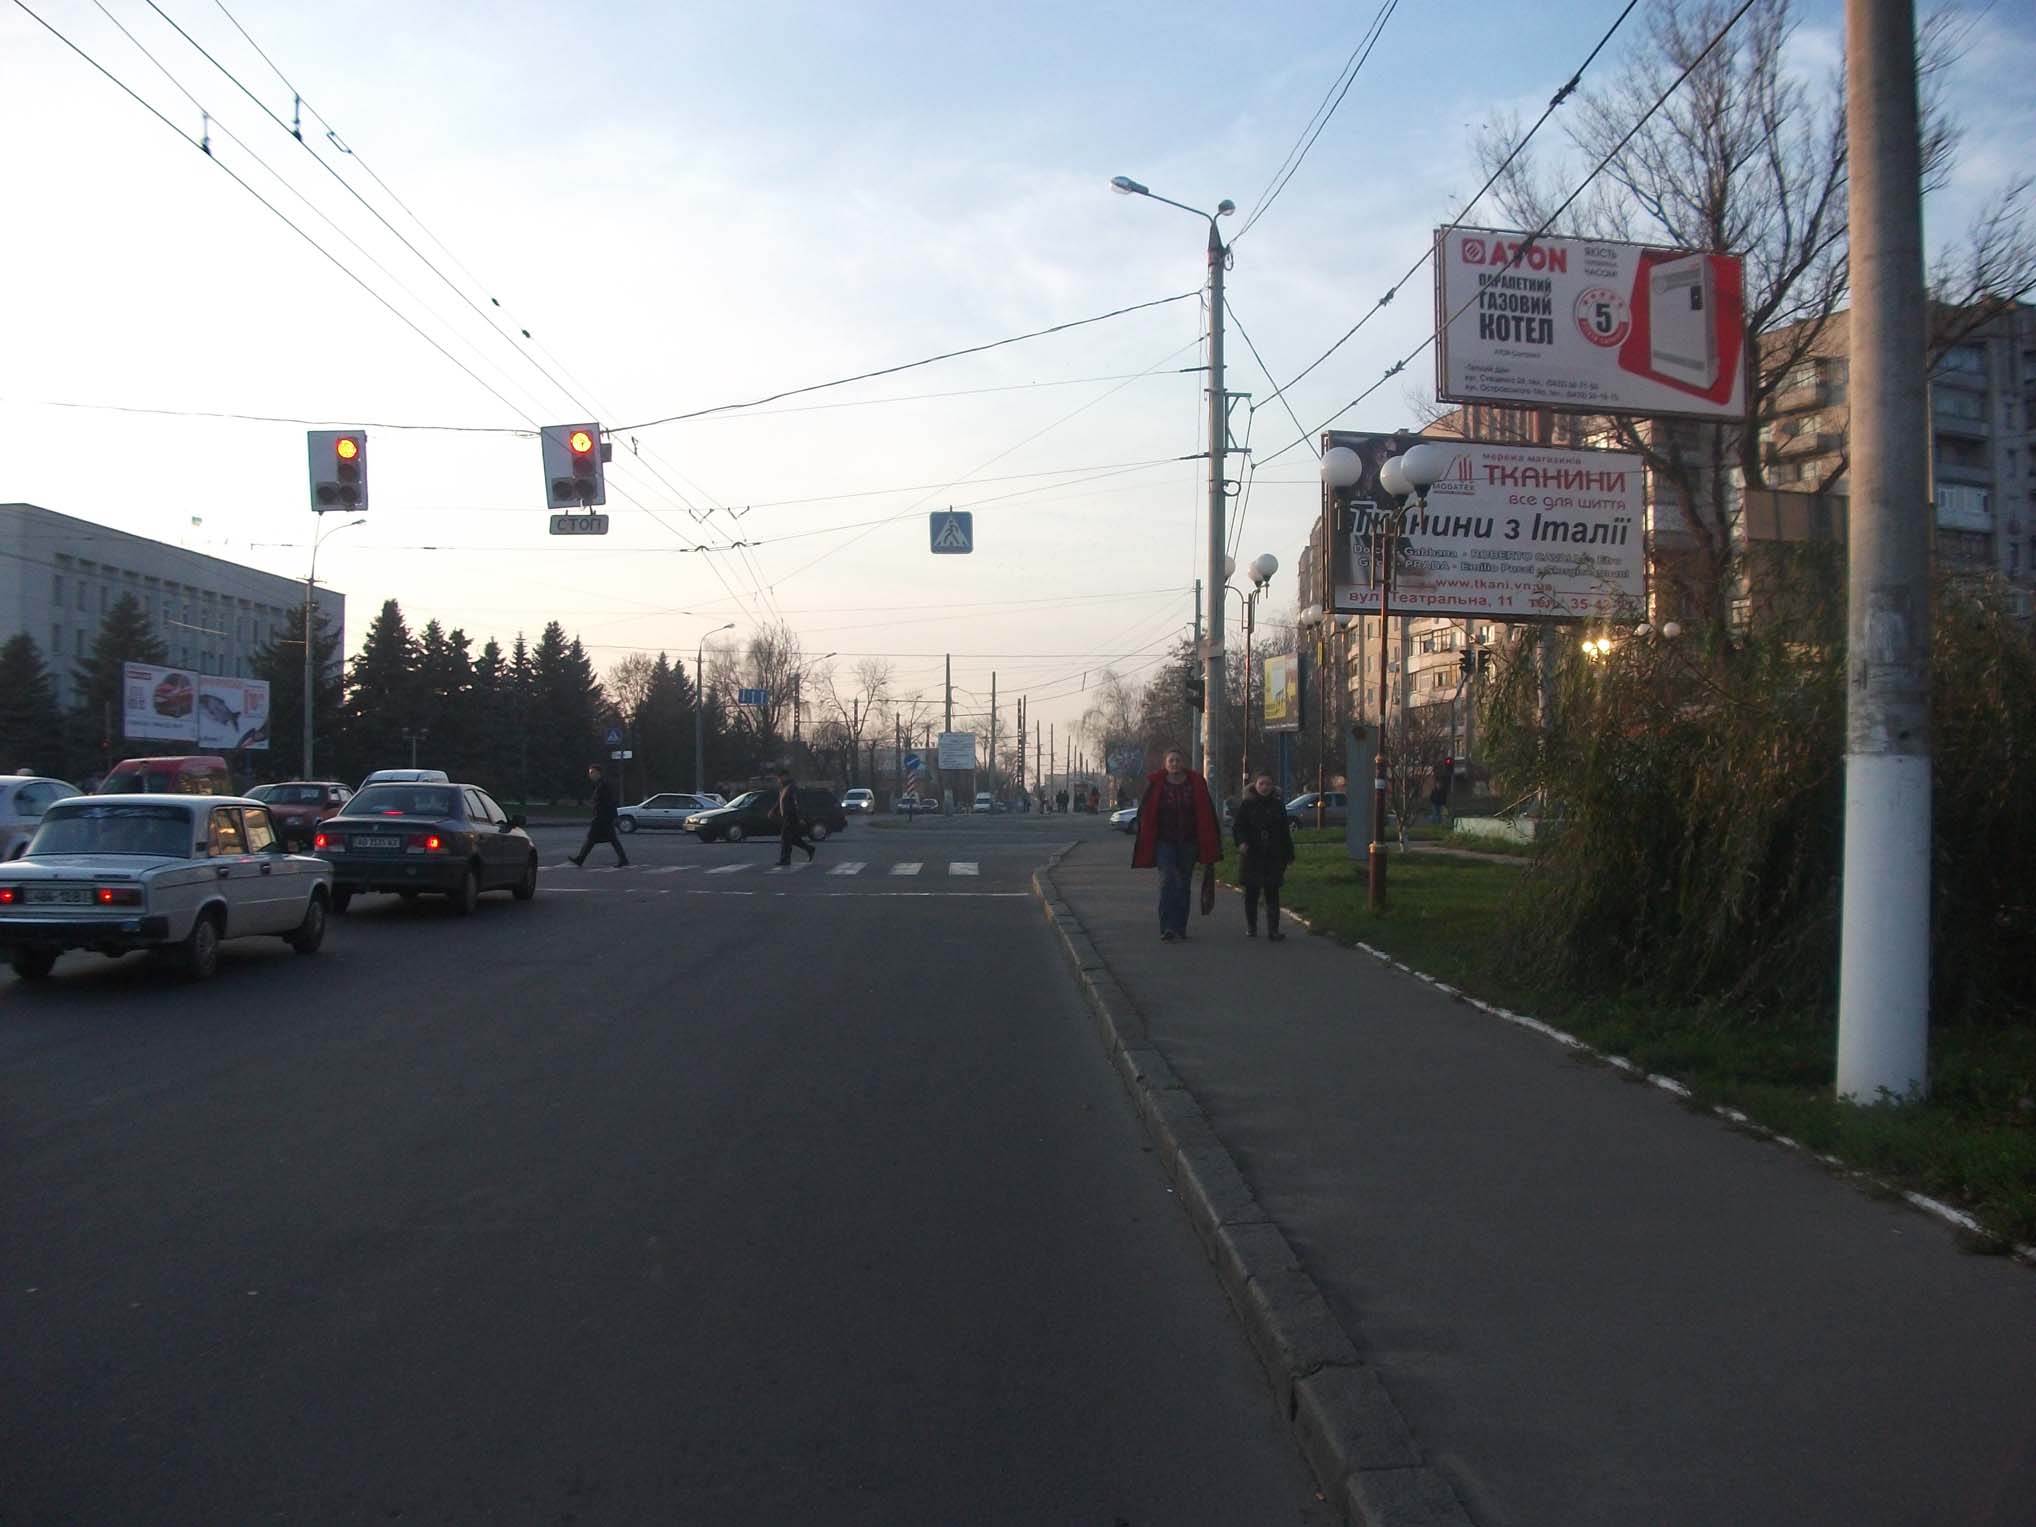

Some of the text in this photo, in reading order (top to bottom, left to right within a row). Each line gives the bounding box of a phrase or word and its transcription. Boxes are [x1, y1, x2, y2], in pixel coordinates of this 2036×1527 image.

[1489, 240, 1567, 273] ATON
[1478, 272, 1553, 292] ПАРАПЕТНИЙ
[1479, 290, 1553, 315] ГАЗОВИЙ
[1479, 312, 1554, 345] КОТЕЛ
[1595, 303, 1612, 333] 5
[1482, 464, 1626, 493] ТКАНИНИ
[1509, 494, 1626, 511] все для шиття
[557, 518, 601, 531] СТОП
[1504, 518, 1520, 540] з
[1531, 512, 1632, 545] Італії
[1405, 560, 1450, 572] PRADA
[1498, 595, 1512, 607] 11
